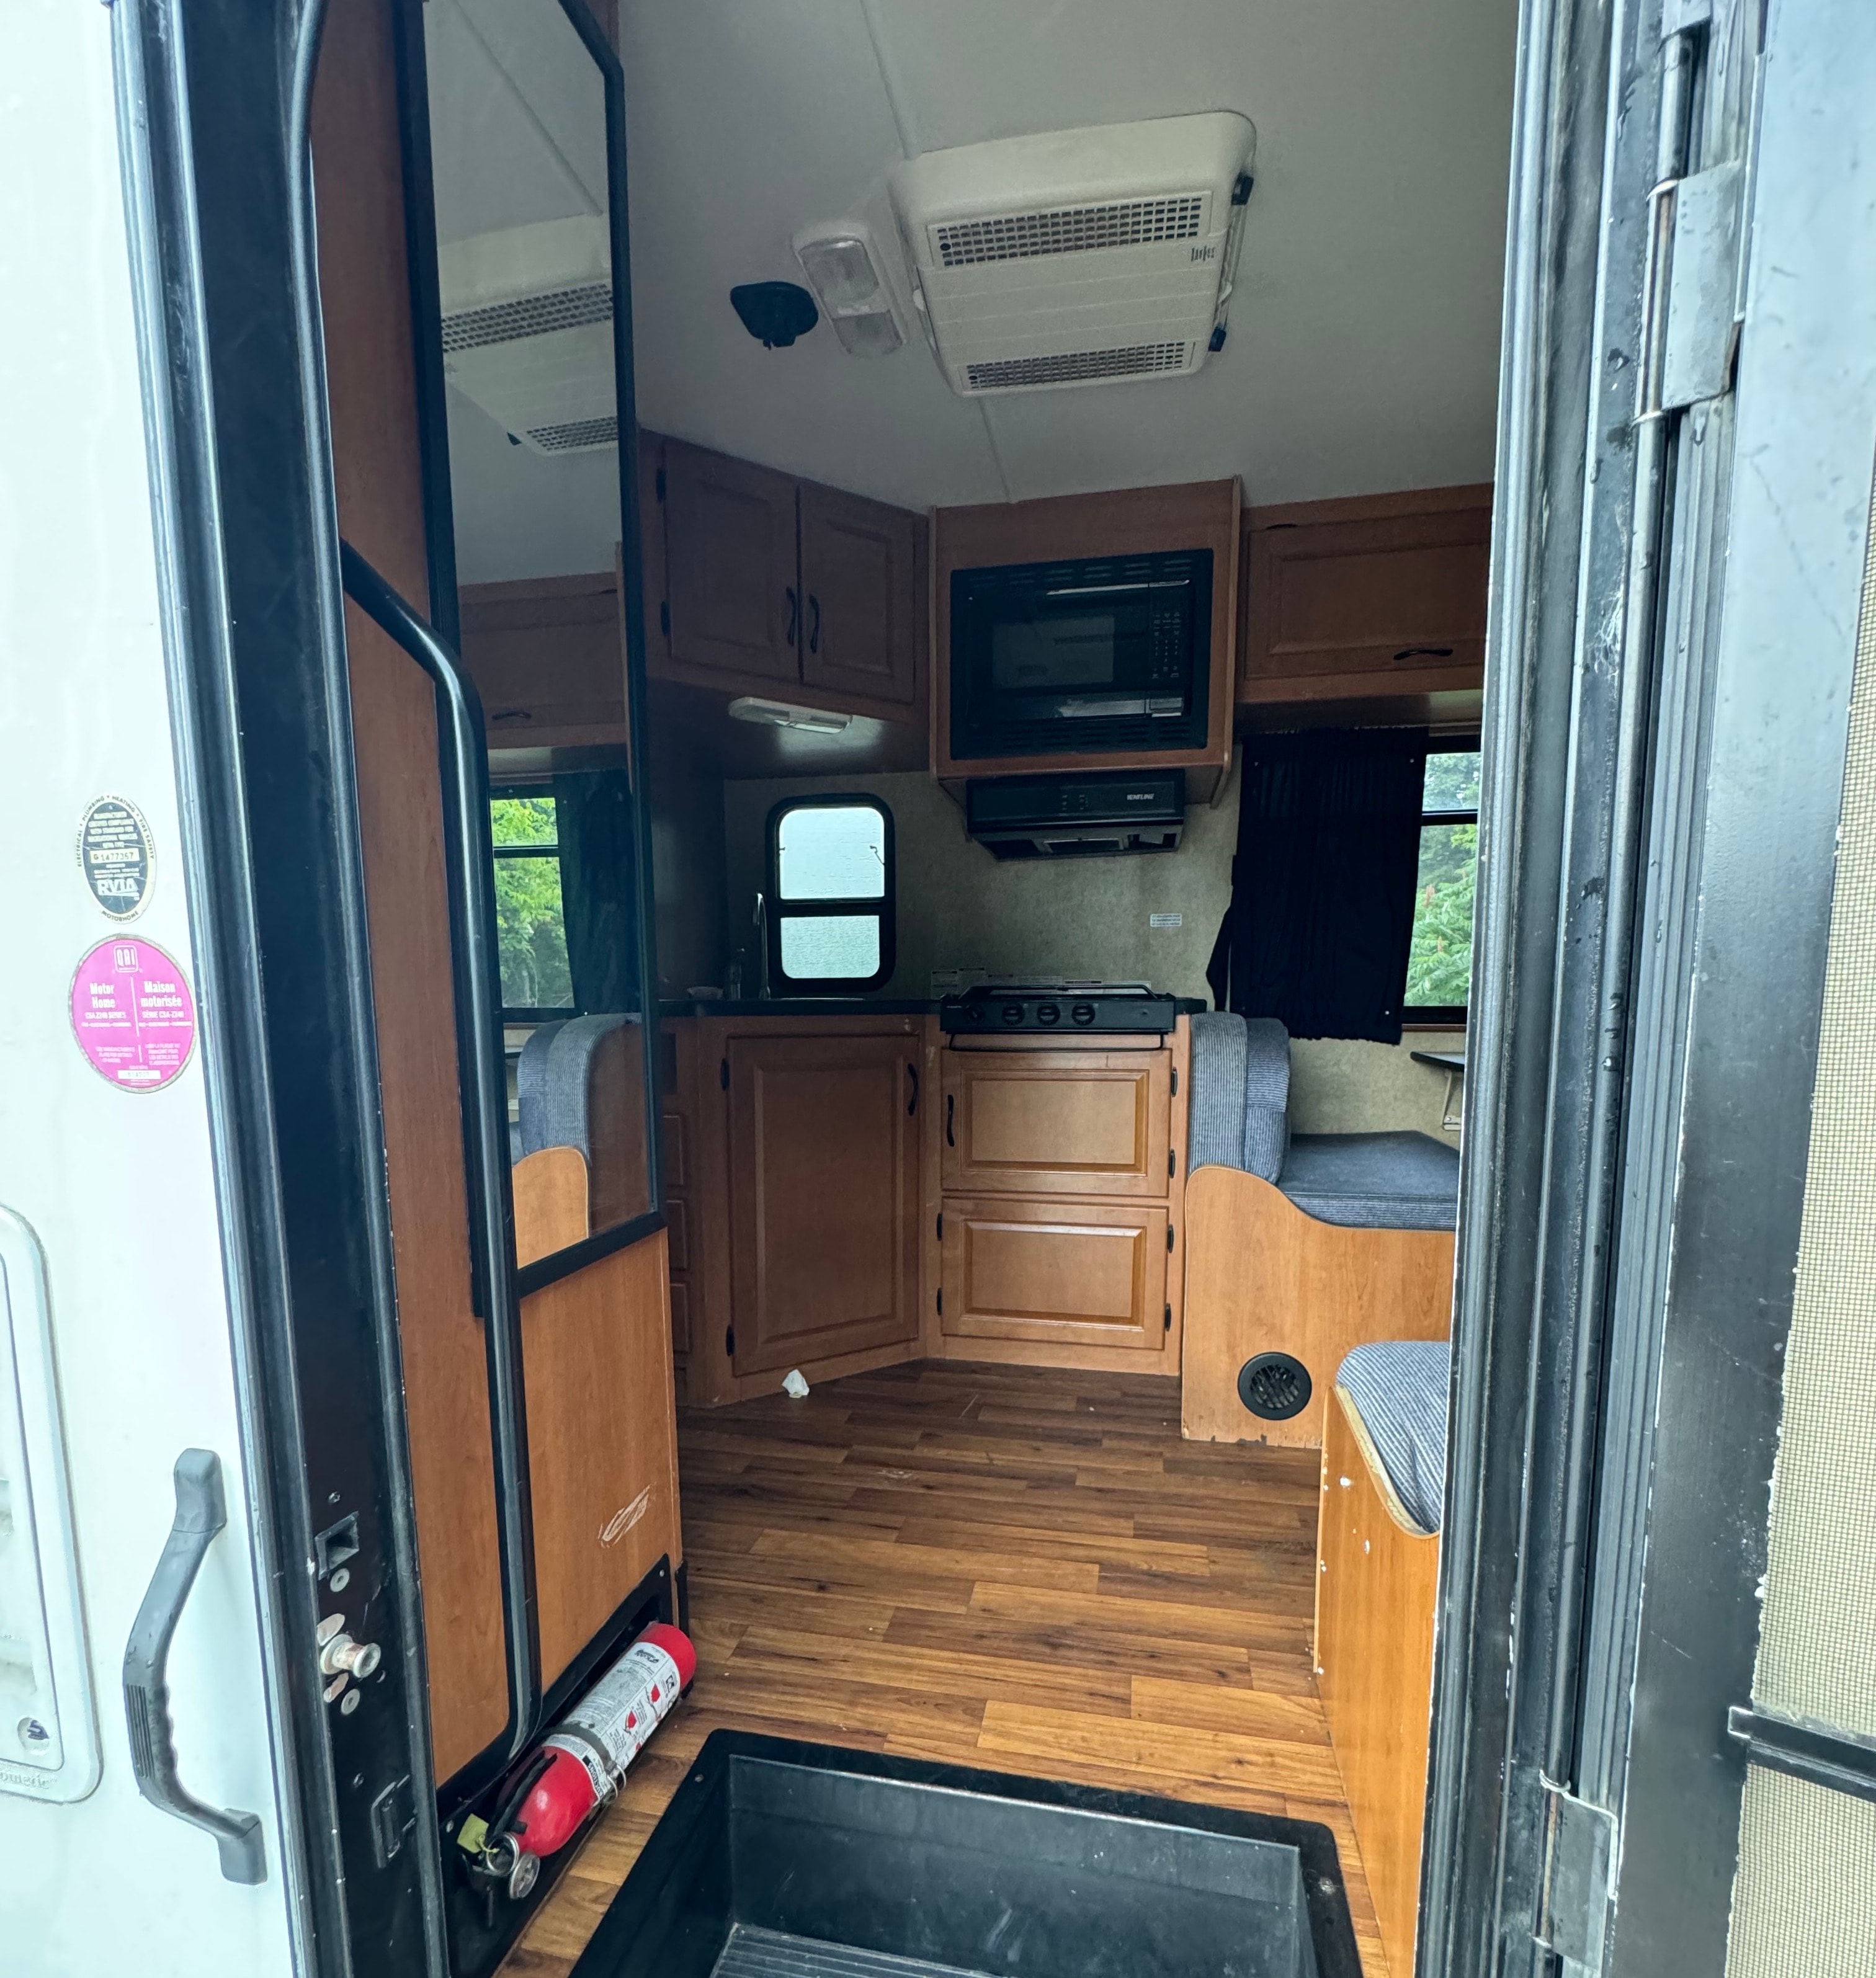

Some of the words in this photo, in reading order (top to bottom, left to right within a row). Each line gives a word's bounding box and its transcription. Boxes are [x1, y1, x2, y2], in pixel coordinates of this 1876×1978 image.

[97, 878, 139, 894] RVIA
[90, 983, 114, 994] Motor
[144, 981, 175, 993] Maison
[92, 997, 115, 1008] Home
[141, 996, 182, 1007] motorisée
